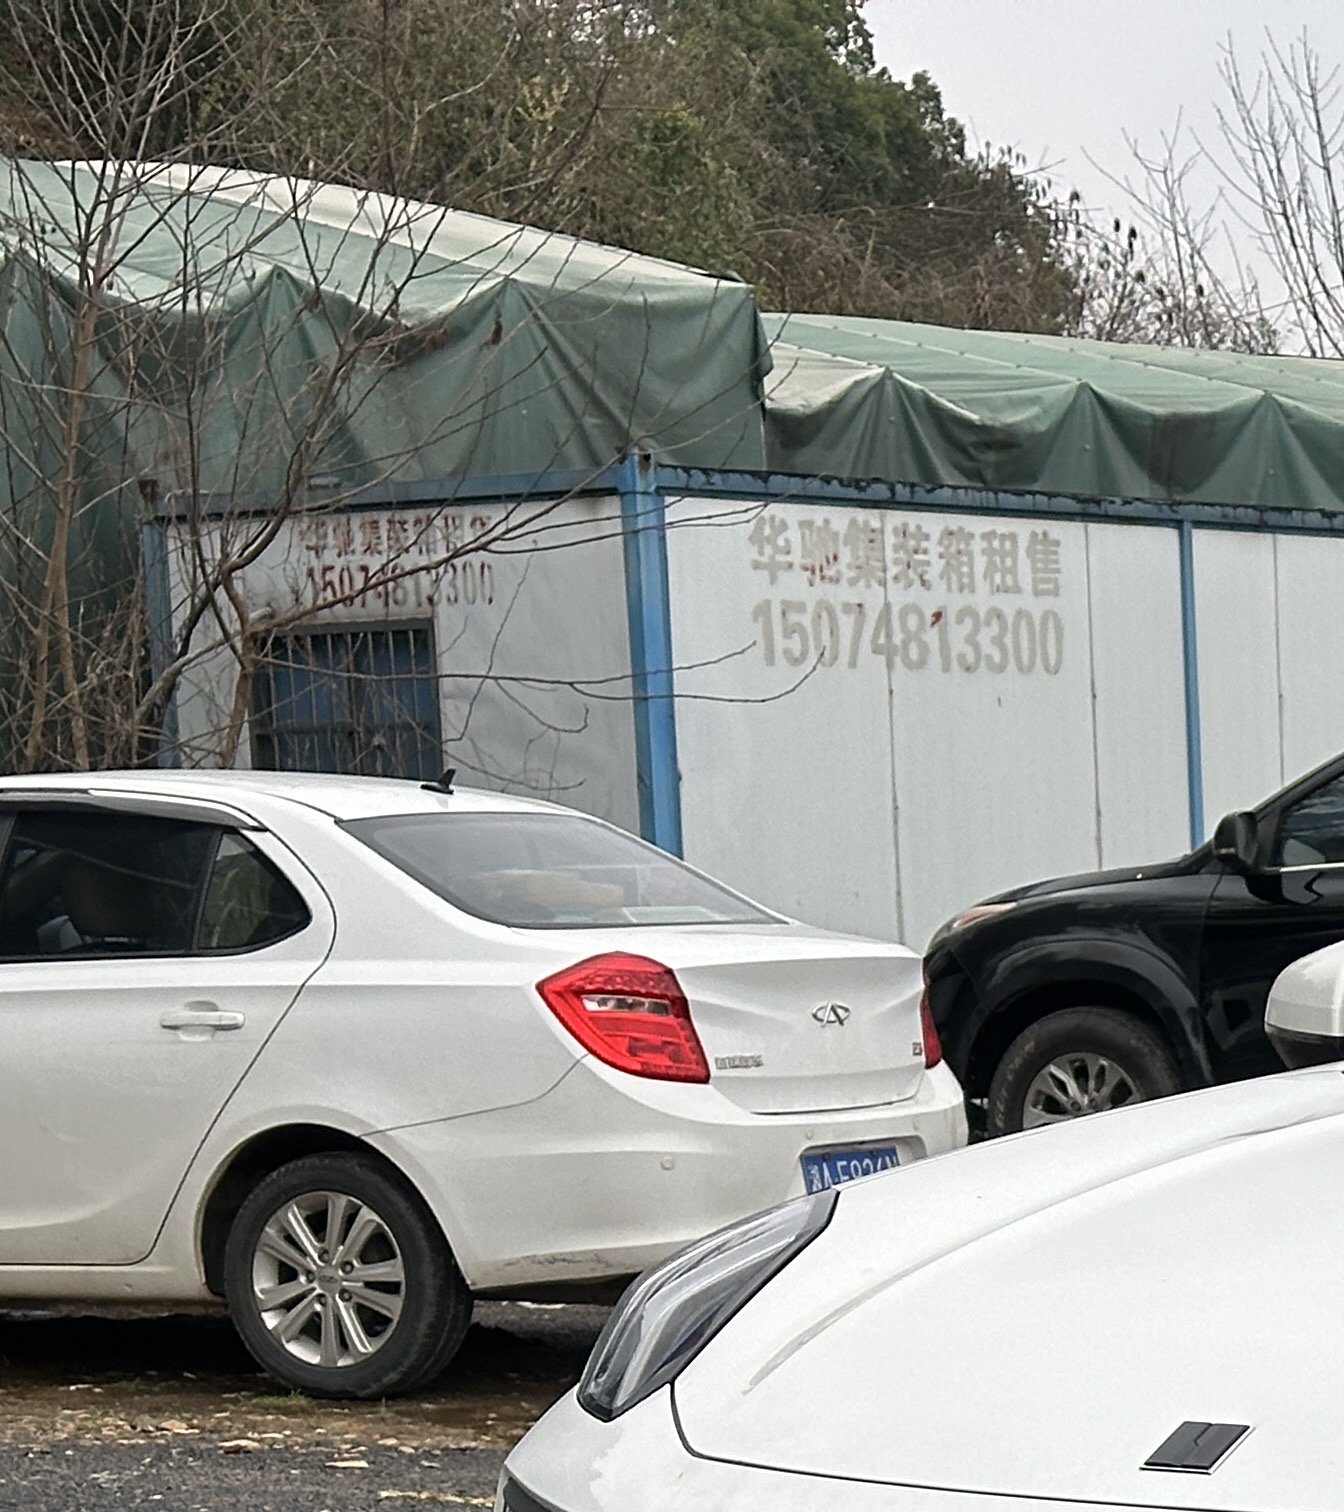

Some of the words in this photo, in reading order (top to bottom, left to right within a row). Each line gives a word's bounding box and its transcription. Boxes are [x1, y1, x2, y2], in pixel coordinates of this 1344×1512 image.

[748, 514, 1062, 597] 华驰集装箱租售
[752, 599, 1064, 676] 15074813300
